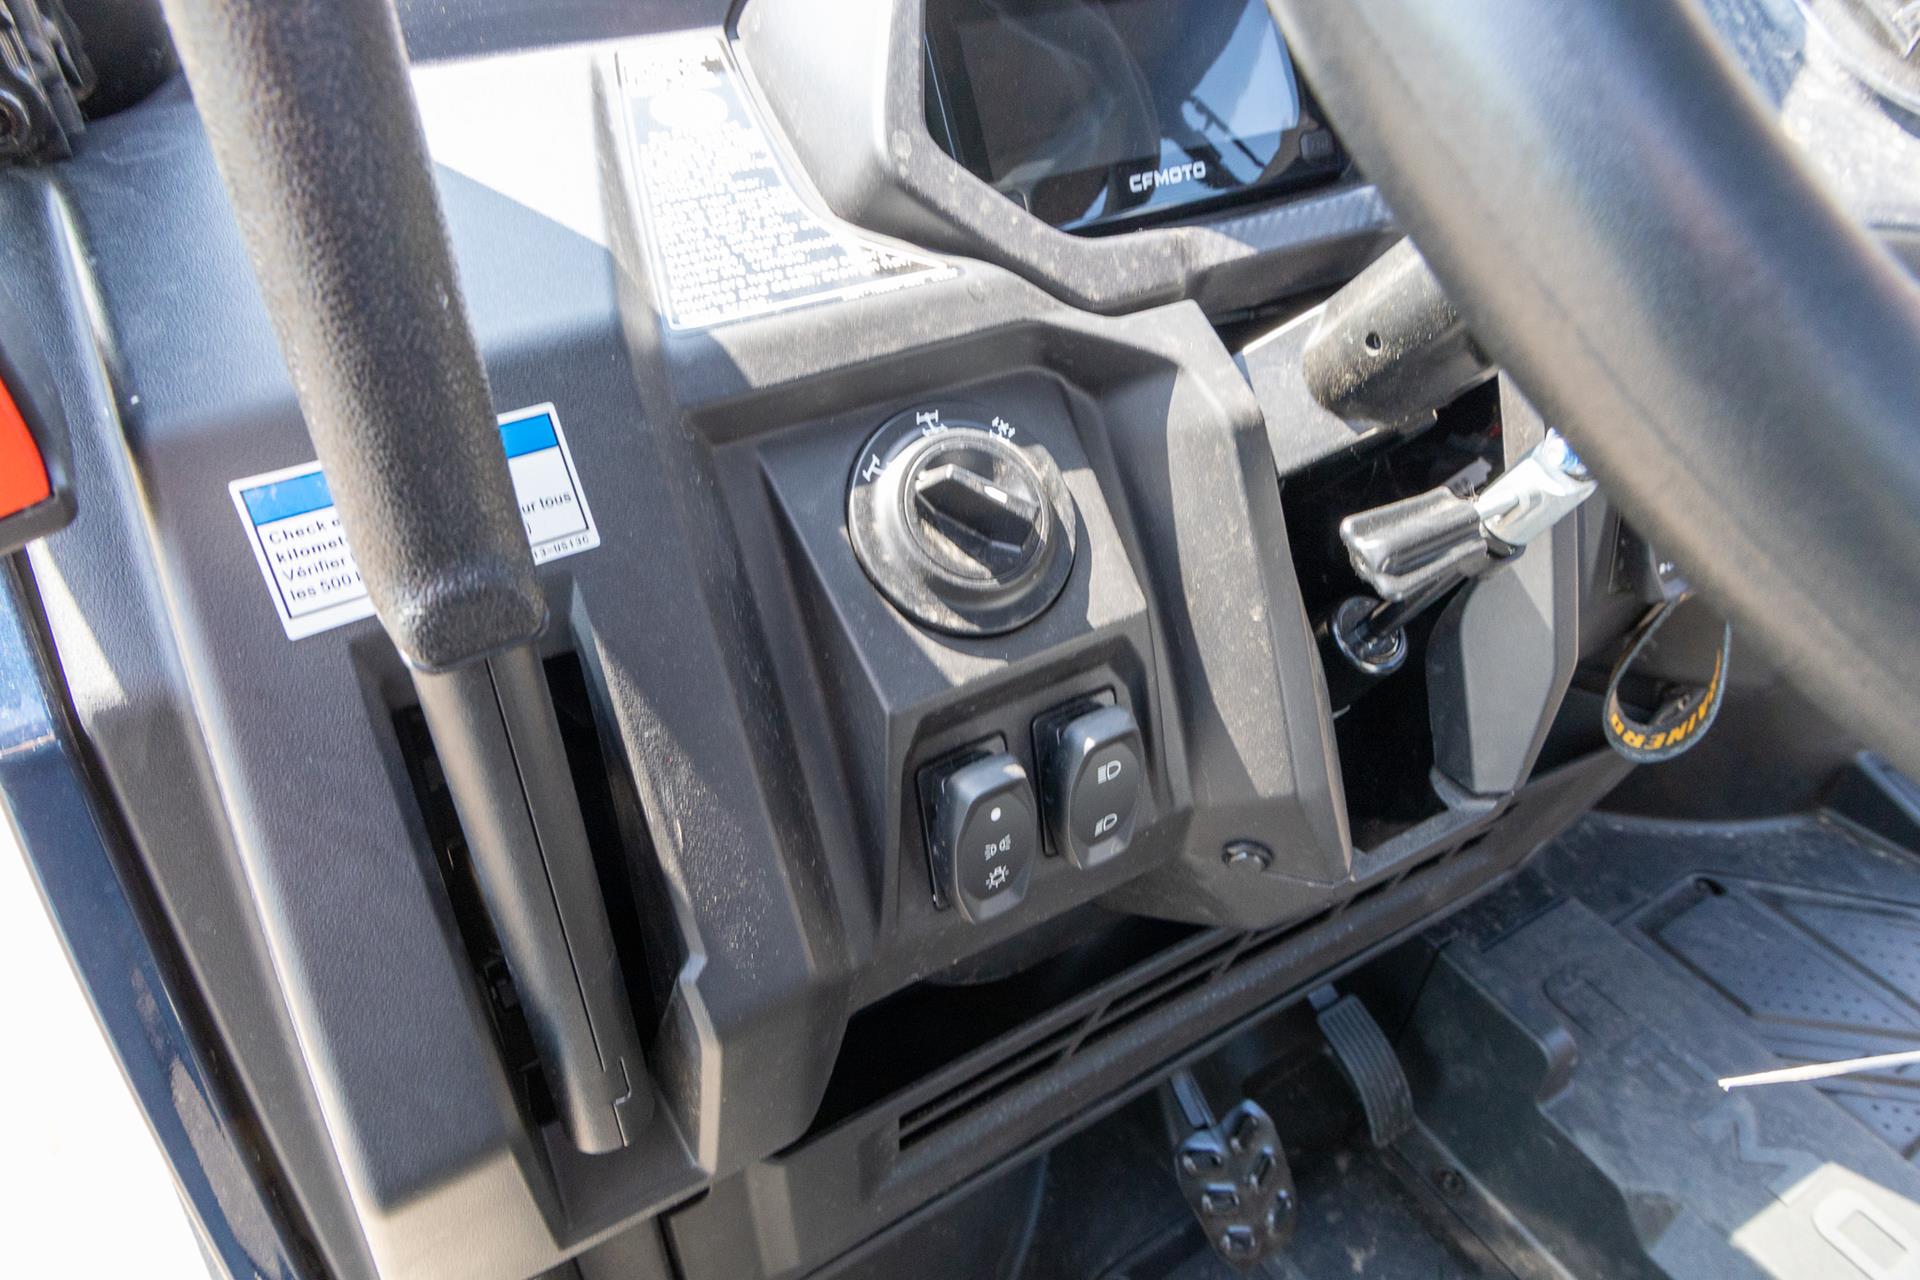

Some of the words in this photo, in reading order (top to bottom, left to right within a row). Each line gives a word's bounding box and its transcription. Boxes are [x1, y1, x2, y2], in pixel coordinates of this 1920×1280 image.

[1128, 160, 1207, 193] CFMOTO
[268, 519, 327, 544] Check
[282, 557, 346, 581] Vérifier
[538, 493, 570, 509] tous
[275, 535, 346, 563] kilomet
[290, 586, 317, 601] les
[320, 573, 352, 592] 500
